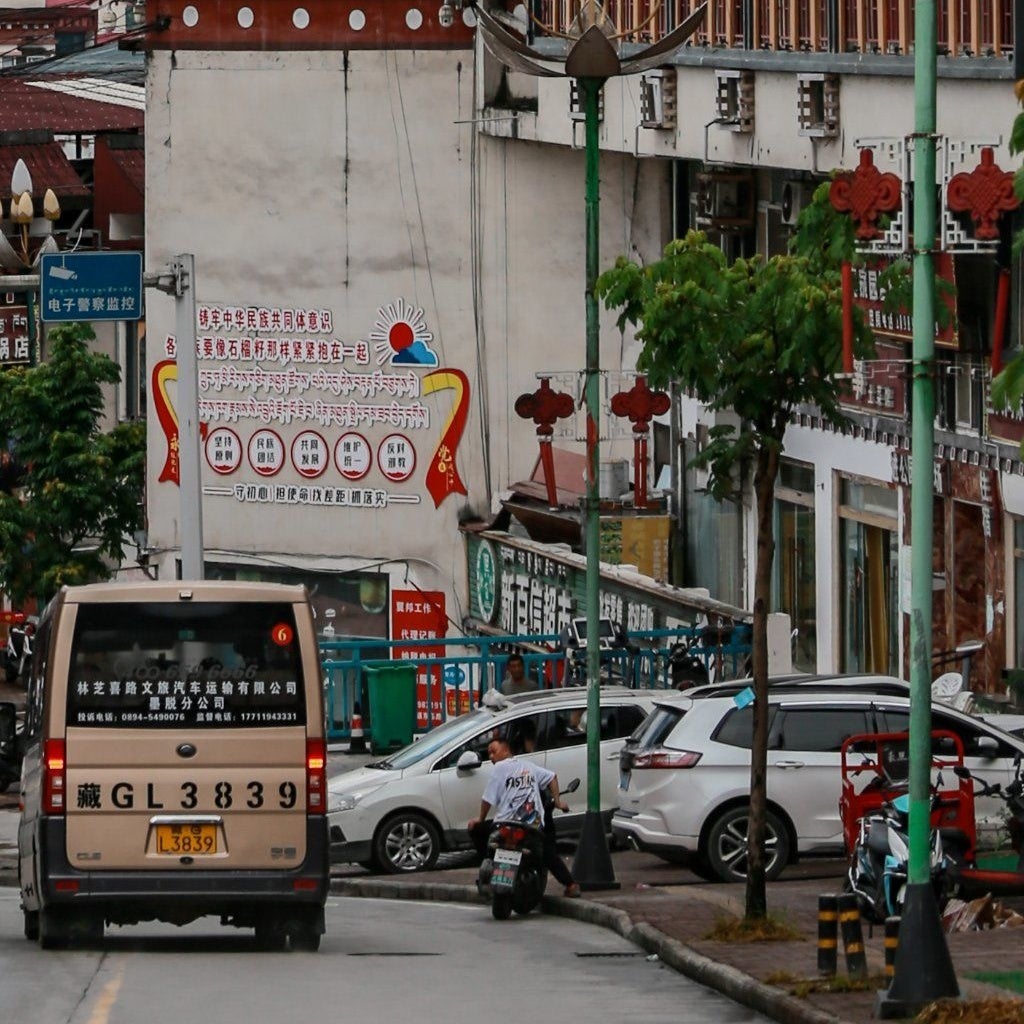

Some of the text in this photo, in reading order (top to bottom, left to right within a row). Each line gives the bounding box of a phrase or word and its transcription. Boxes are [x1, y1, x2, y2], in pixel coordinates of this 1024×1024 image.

[48, 296, 135, 313] 电子警察监控
[199, 307, 332, 331] 铸牢中华民族共同体意识
[166, 336, 368, 362] 各要像石榴籽那样紧紧抱在一起
[257, 438, 274, 449] 民族
[301, 454, 319, 465] 发展
[278, 628, 287, 642] 6
[77, 680, 297, 695] 林芝喜路文旅汽车运输有限公司
[149, 696, 225, 710] 墨脱分公司
[159, 836, 214, 852] L3839
